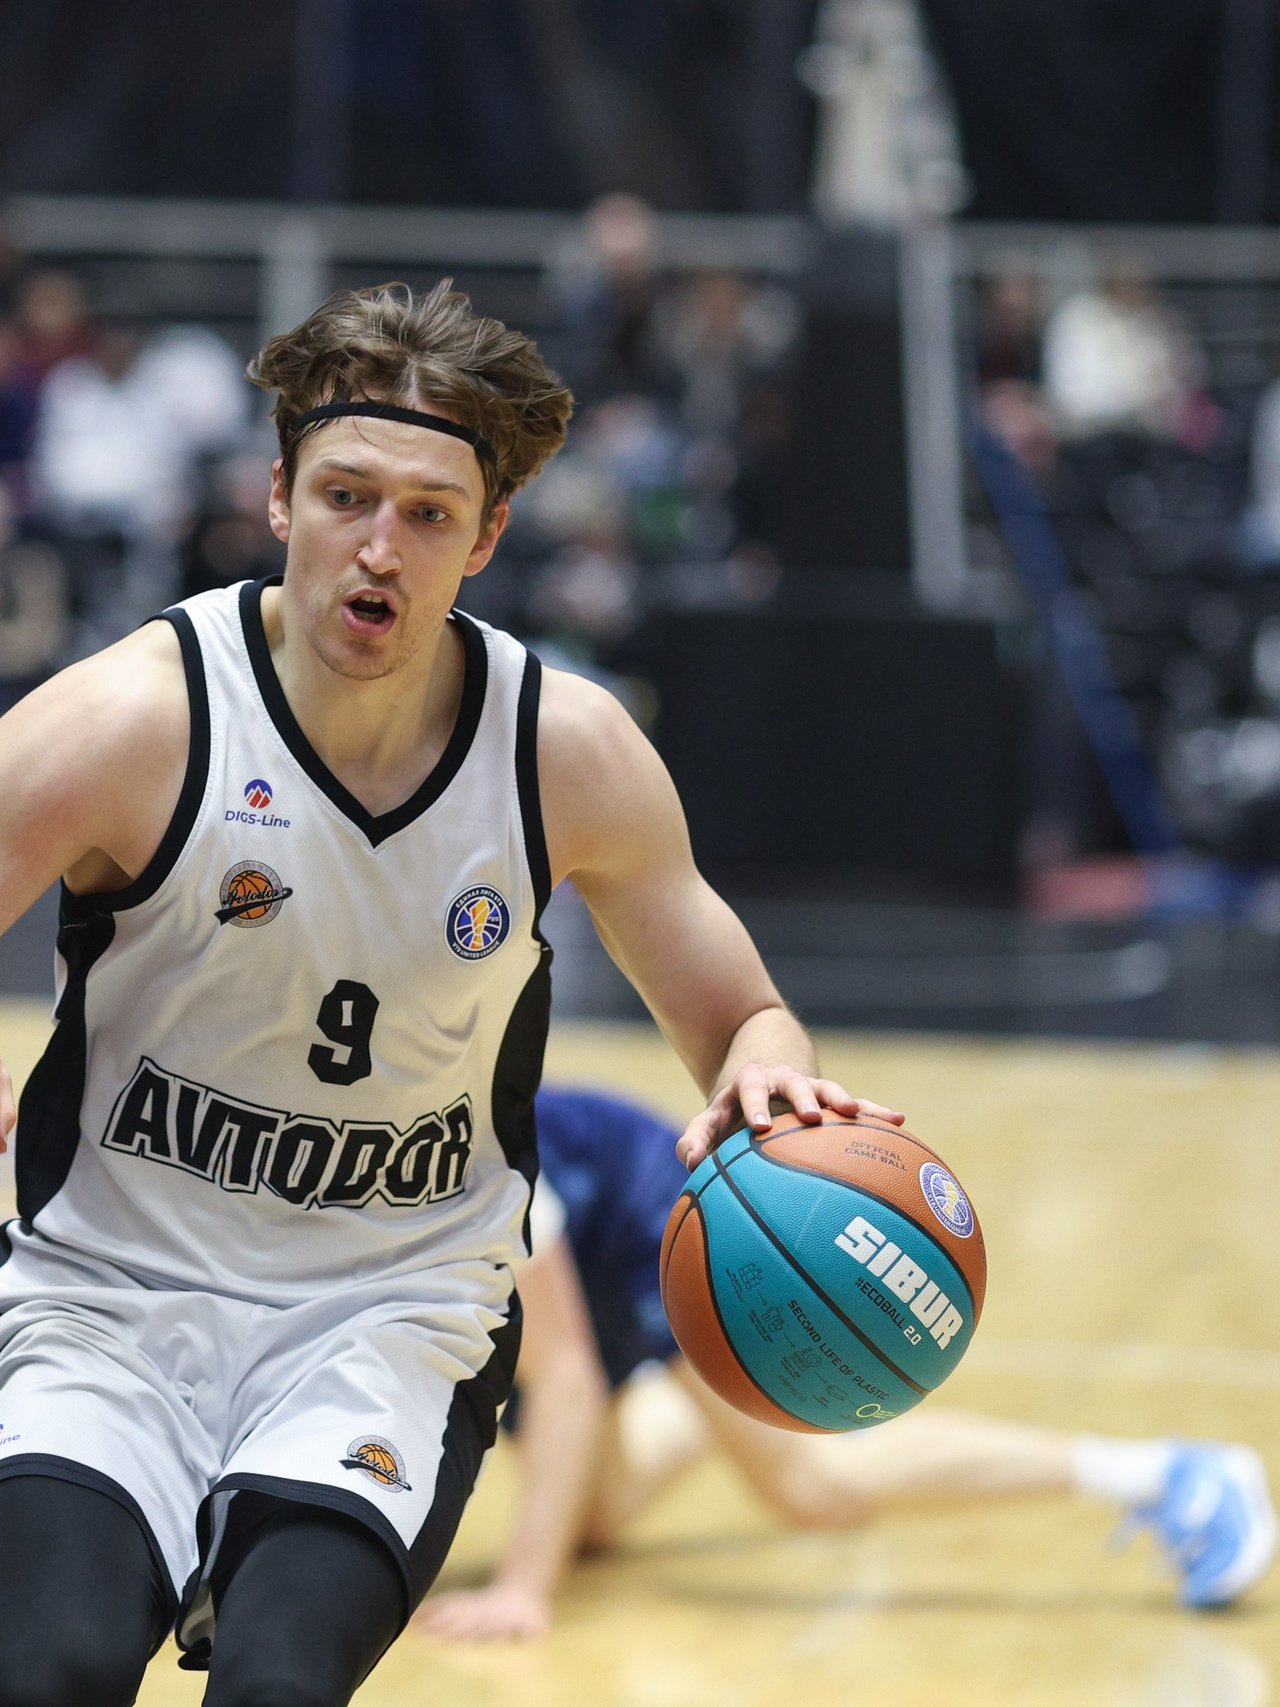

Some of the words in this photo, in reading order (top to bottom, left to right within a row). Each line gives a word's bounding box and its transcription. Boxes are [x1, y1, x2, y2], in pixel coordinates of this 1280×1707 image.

[224, 810, 291, 828] DIGS-Line
[480, 889, 495, 898] ЛИГА
[493, 893, 504, 907] ВТБ
[307, 979, 380, 1086] 9
[100, 1055, 473, 1210] AVTODOR
[880, 1156, 907, 1171] BALL
[834, 1216, 963, 1350] SIBUR
[854, 1276, 905, 1330] #ECOBALL
[903, 1325, 922, 1346] 2.0
[788, 1299, 822, 1343] SECOND
[819, 1342, 842, 1366] LIFE
[839, 1364, 855, 1376] OF
[852, 1375, 889, 1400] PLASTIC
